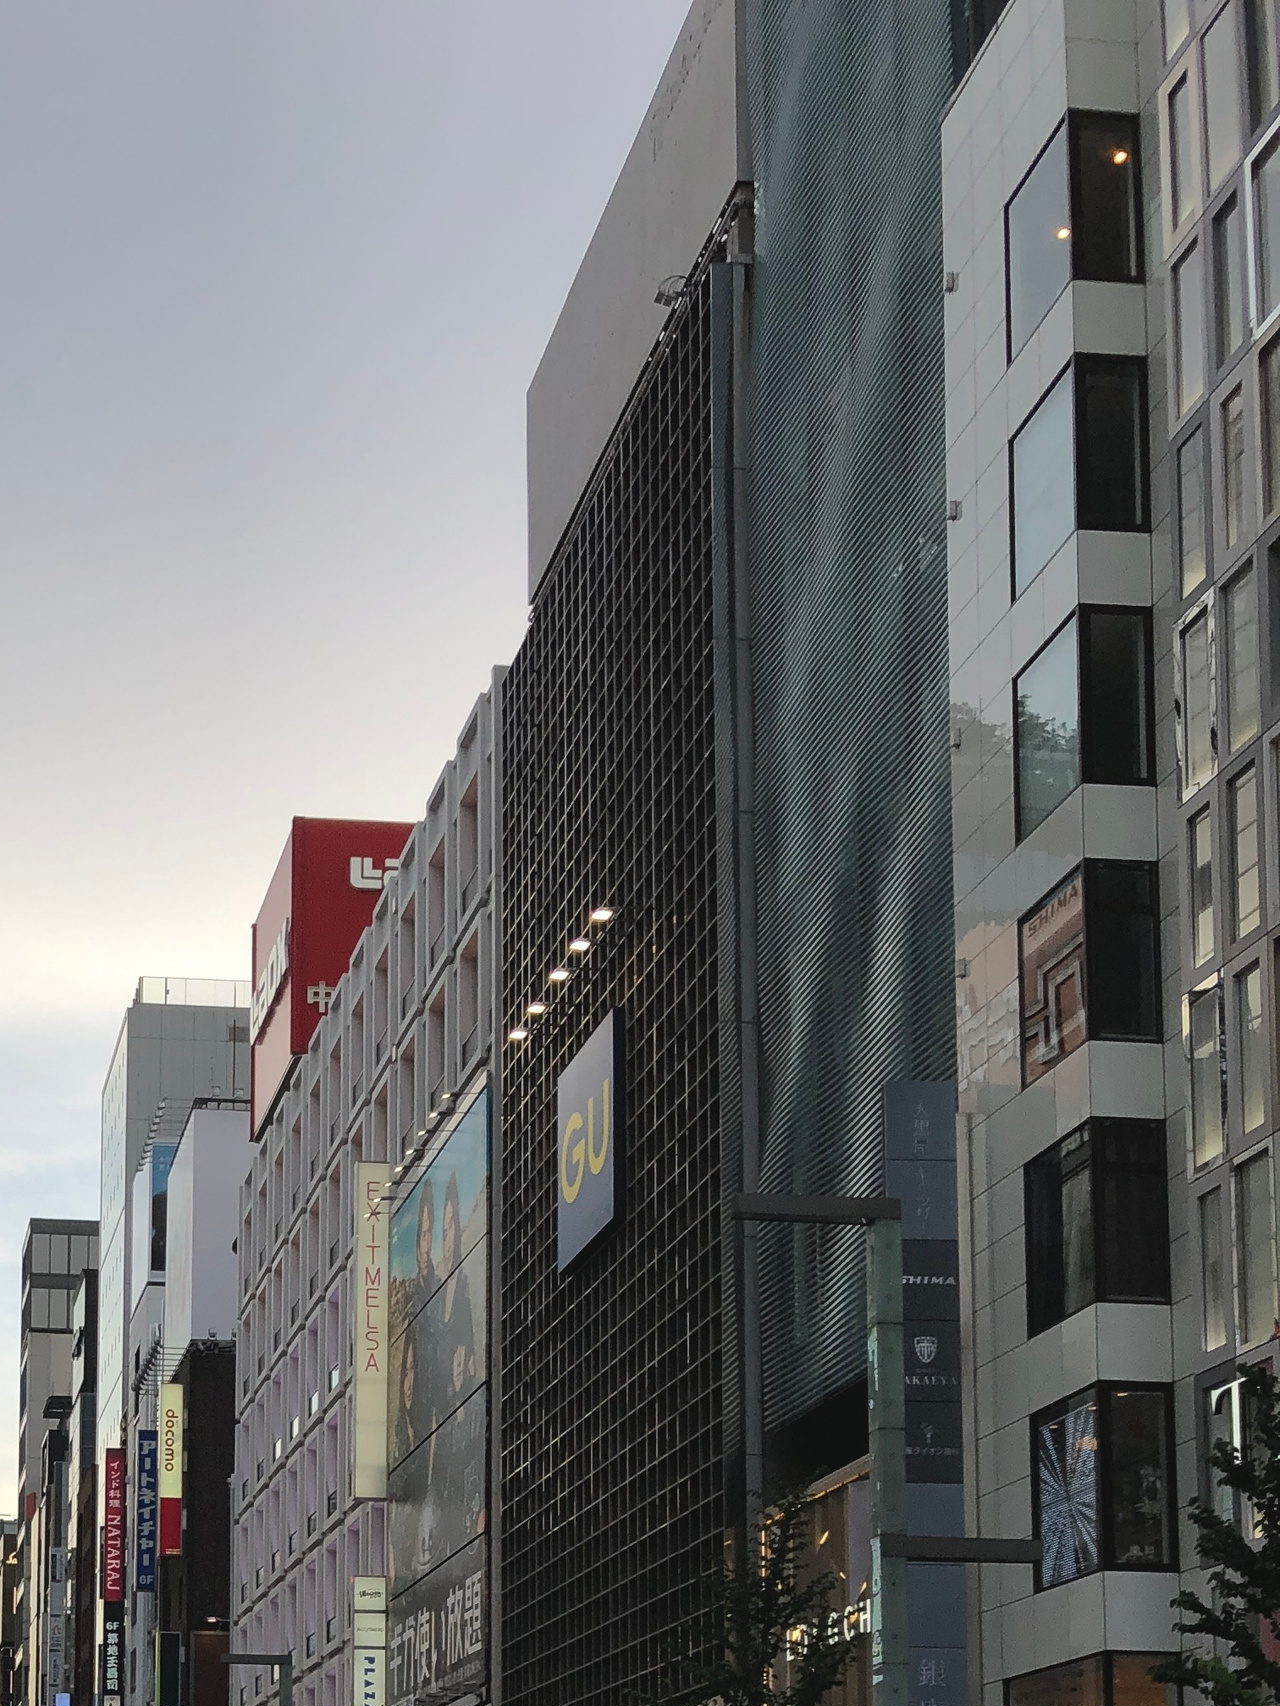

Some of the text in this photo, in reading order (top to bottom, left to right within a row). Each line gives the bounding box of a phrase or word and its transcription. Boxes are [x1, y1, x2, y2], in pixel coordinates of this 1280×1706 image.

[561, 1078, 610, 1204] GU
[364, 1181, 381, 1373] EXITMELSA
[165, 1409, 178, 1472] docomo
[107, 1461, 121, 1590] インド料理 NATARAJ
[139, 1440, 156, 1584] アートネイチャー 6F
[106, 1622, 119, 1631] 6F
